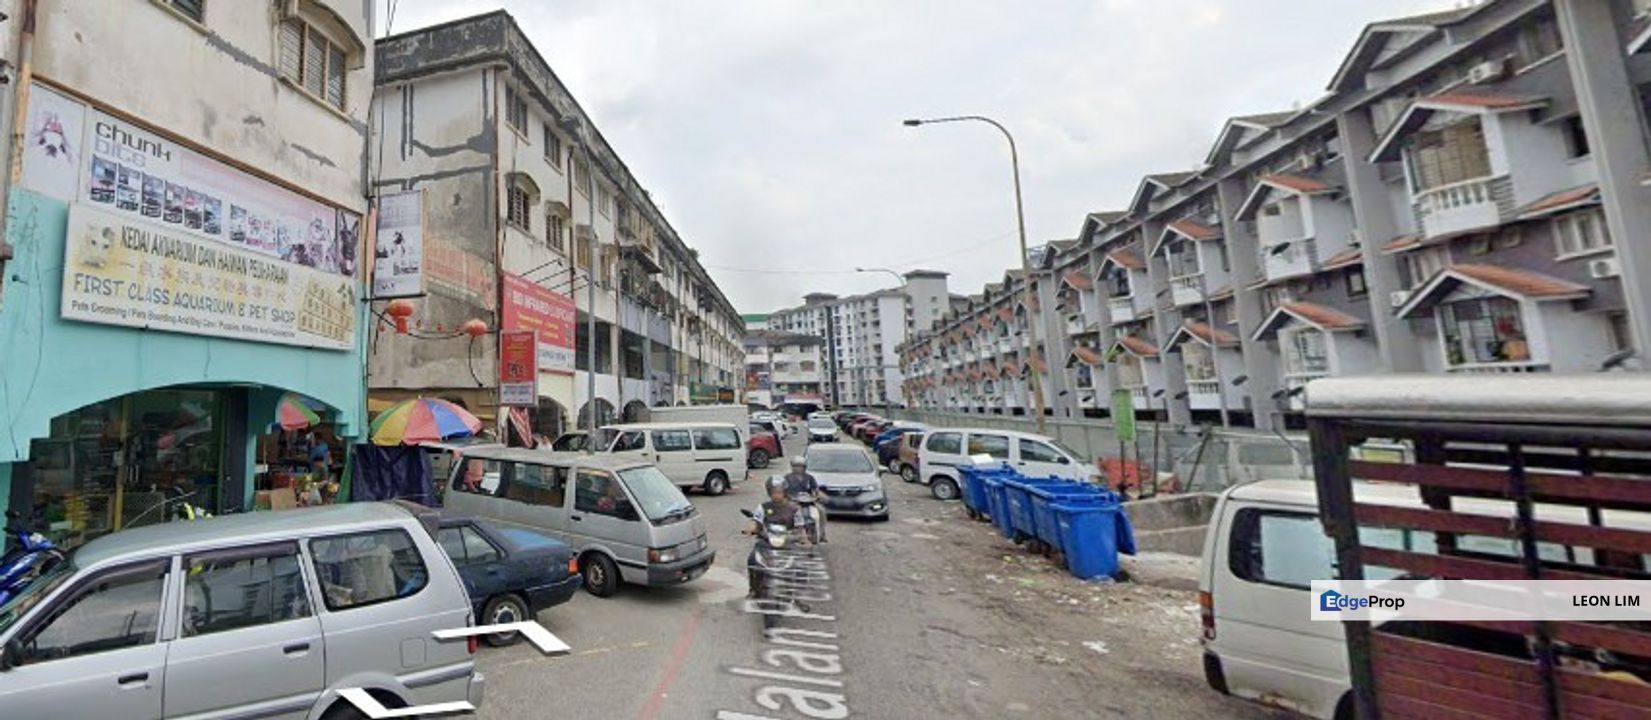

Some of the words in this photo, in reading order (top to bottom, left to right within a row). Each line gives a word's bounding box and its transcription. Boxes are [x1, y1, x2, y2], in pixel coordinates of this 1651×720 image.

[95, 121, 171, 162] chunk
[121, 225, 150, 253] KEDAI
[197, 244, 217, 268] DAN
[74, 273, 124, 297] FIRST
[128, 282, 169, 305] CLASS
[173, 290, 235, 316] AQUARIUM
[249, 303, 268, 319] PET
[271, 308, 296, 324] SHOP
[91, 302, 127, 319] Grooming
